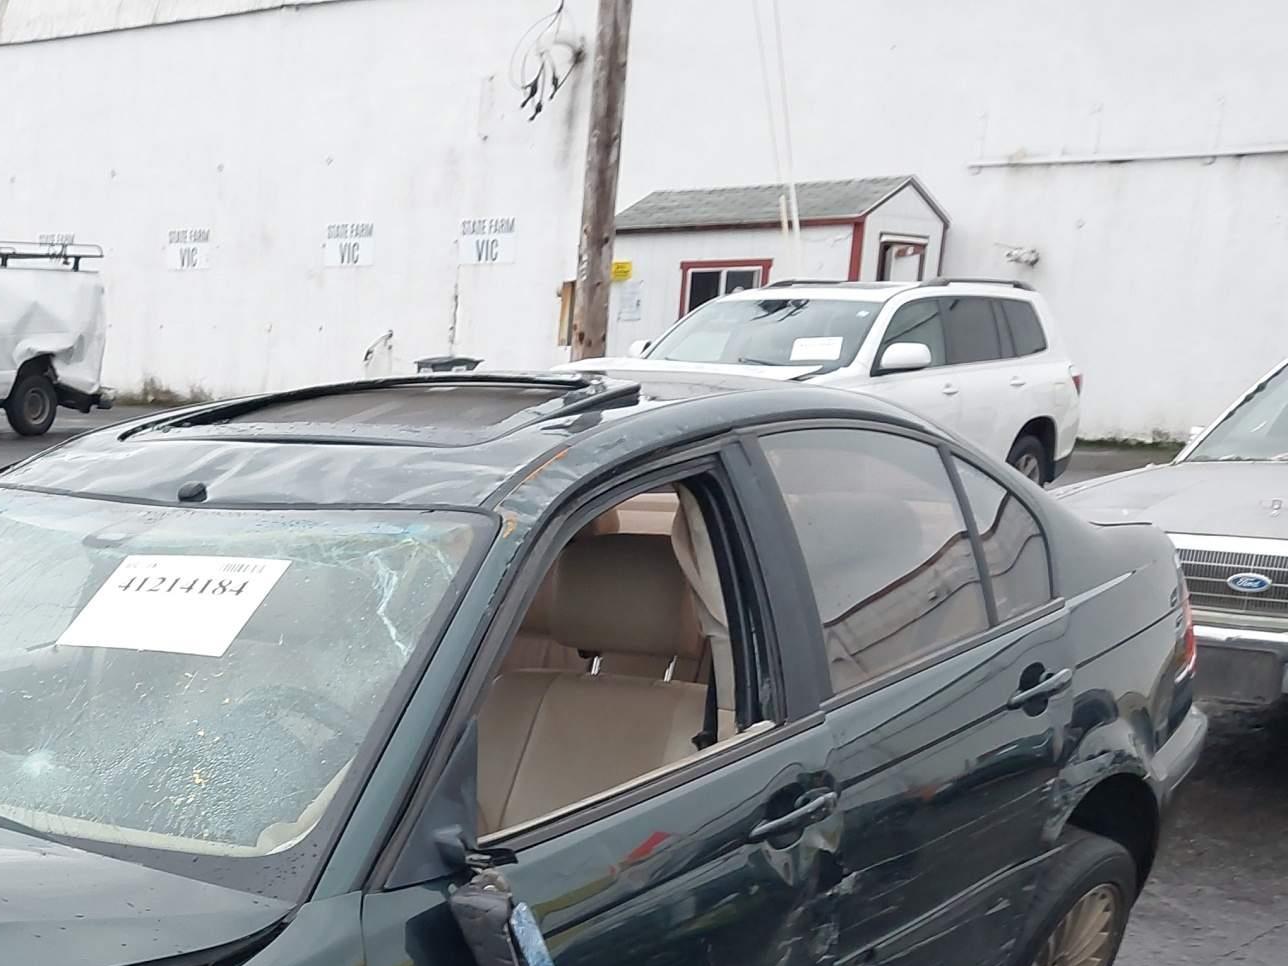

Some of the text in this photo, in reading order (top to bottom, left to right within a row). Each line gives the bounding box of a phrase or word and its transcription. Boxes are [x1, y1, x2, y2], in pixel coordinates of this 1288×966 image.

[327, 223, 374, 239] STATE FARM
[462, 217, 515, 235] STATE FARM
[180, 246, 198, 268] VIC
[339, 242, 360, 264] VIC
[475, 239, 499, 262] VIC
[118, 576, 249, 596] 41214184
